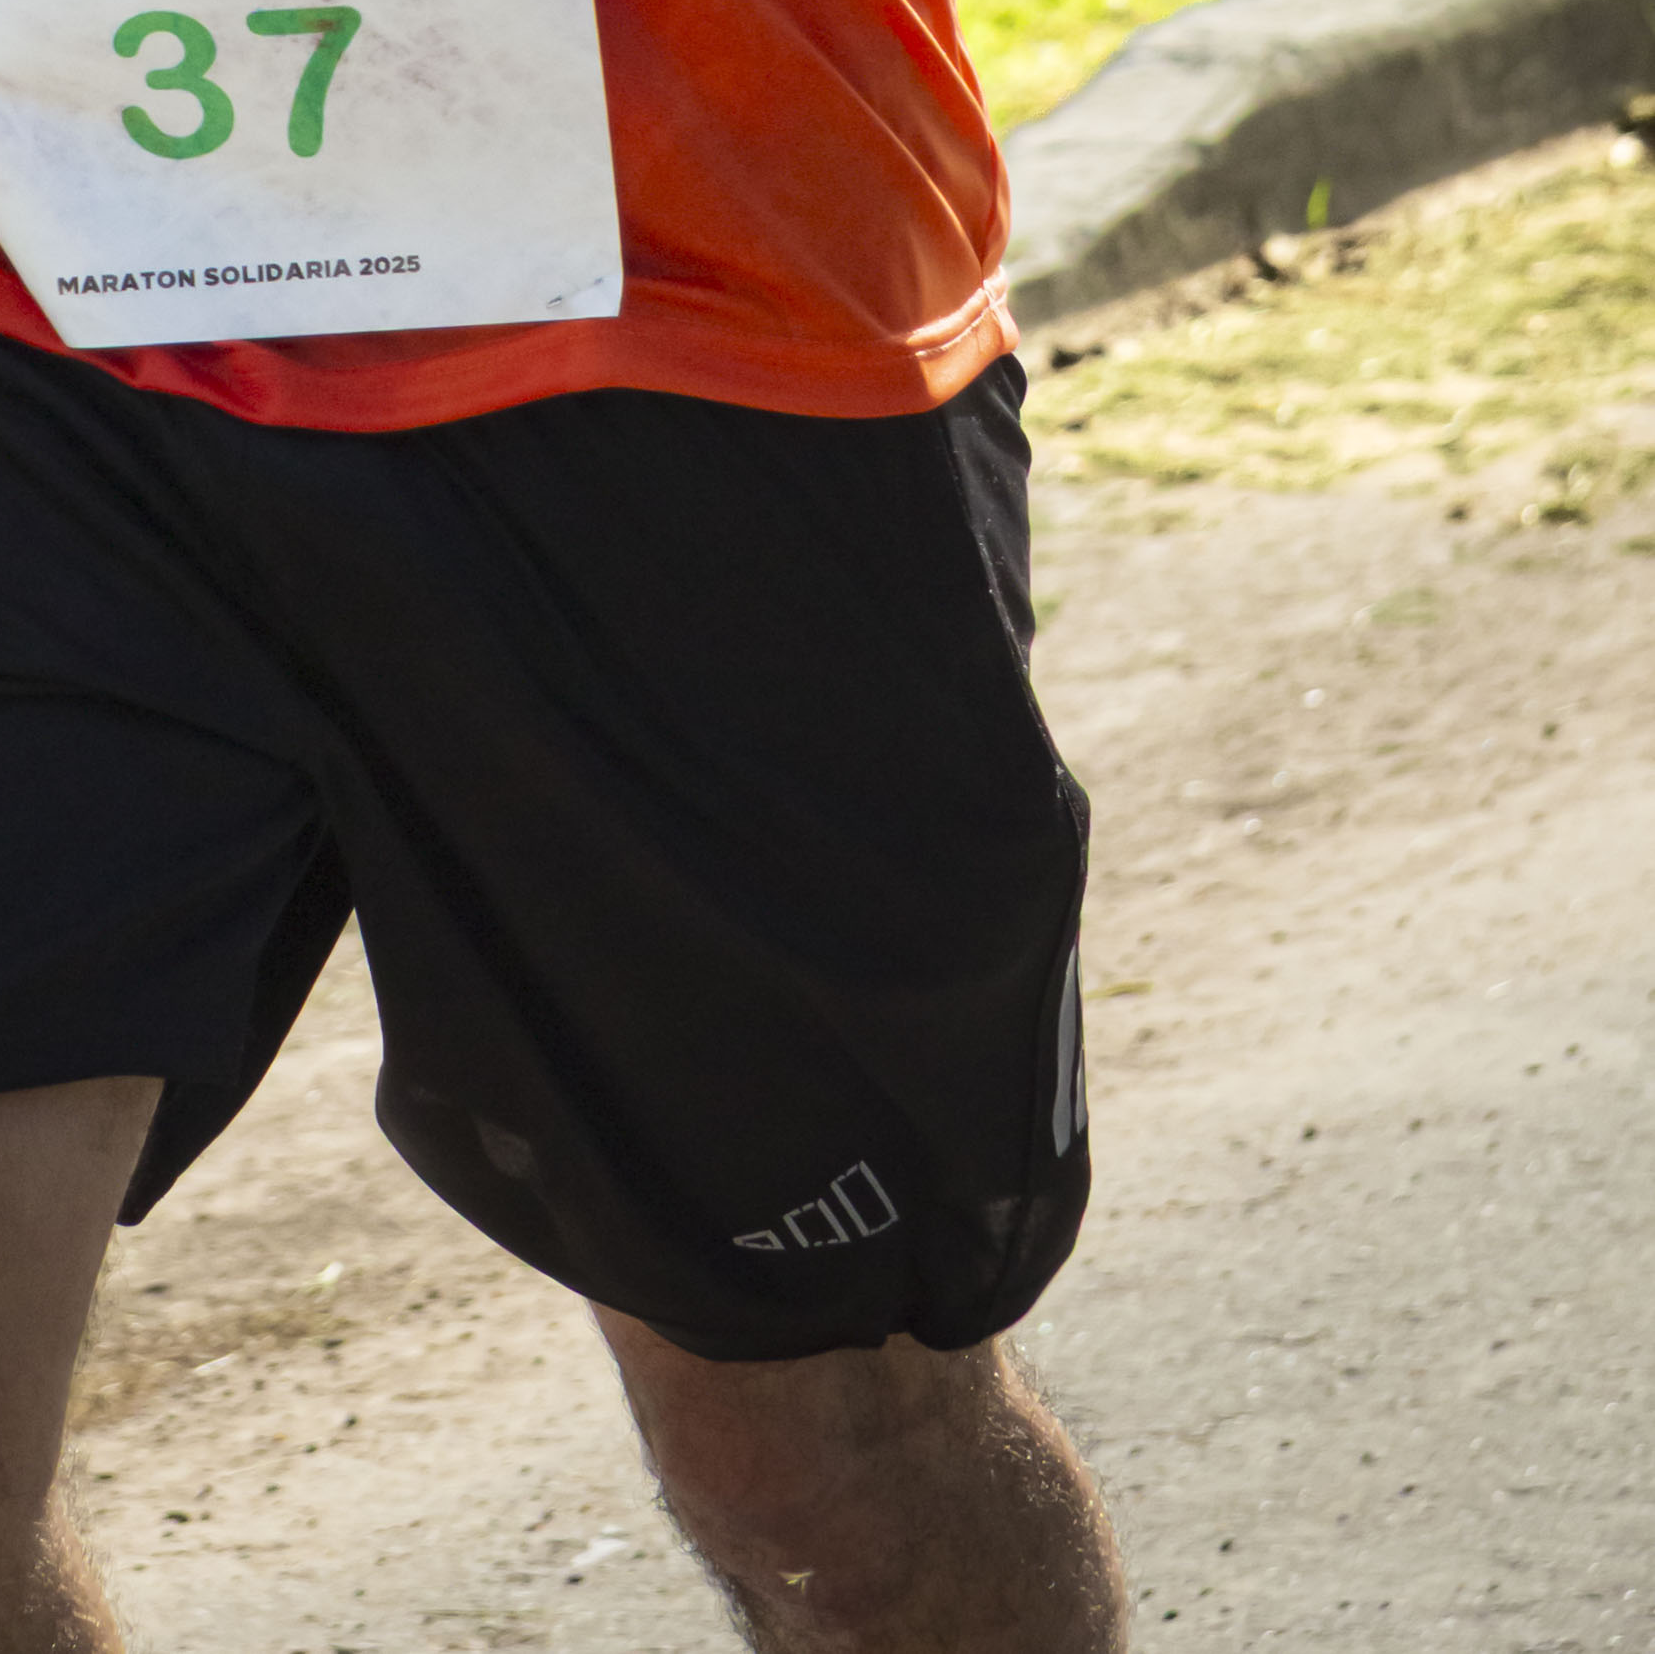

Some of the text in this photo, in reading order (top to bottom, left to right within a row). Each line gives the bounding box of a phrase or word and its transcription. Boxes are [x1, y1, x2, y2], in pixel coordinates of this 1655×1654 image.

[112, 6, 362, 160] 37
[57, 254, 421, 296] MARATON SOLIDARIA 2025
